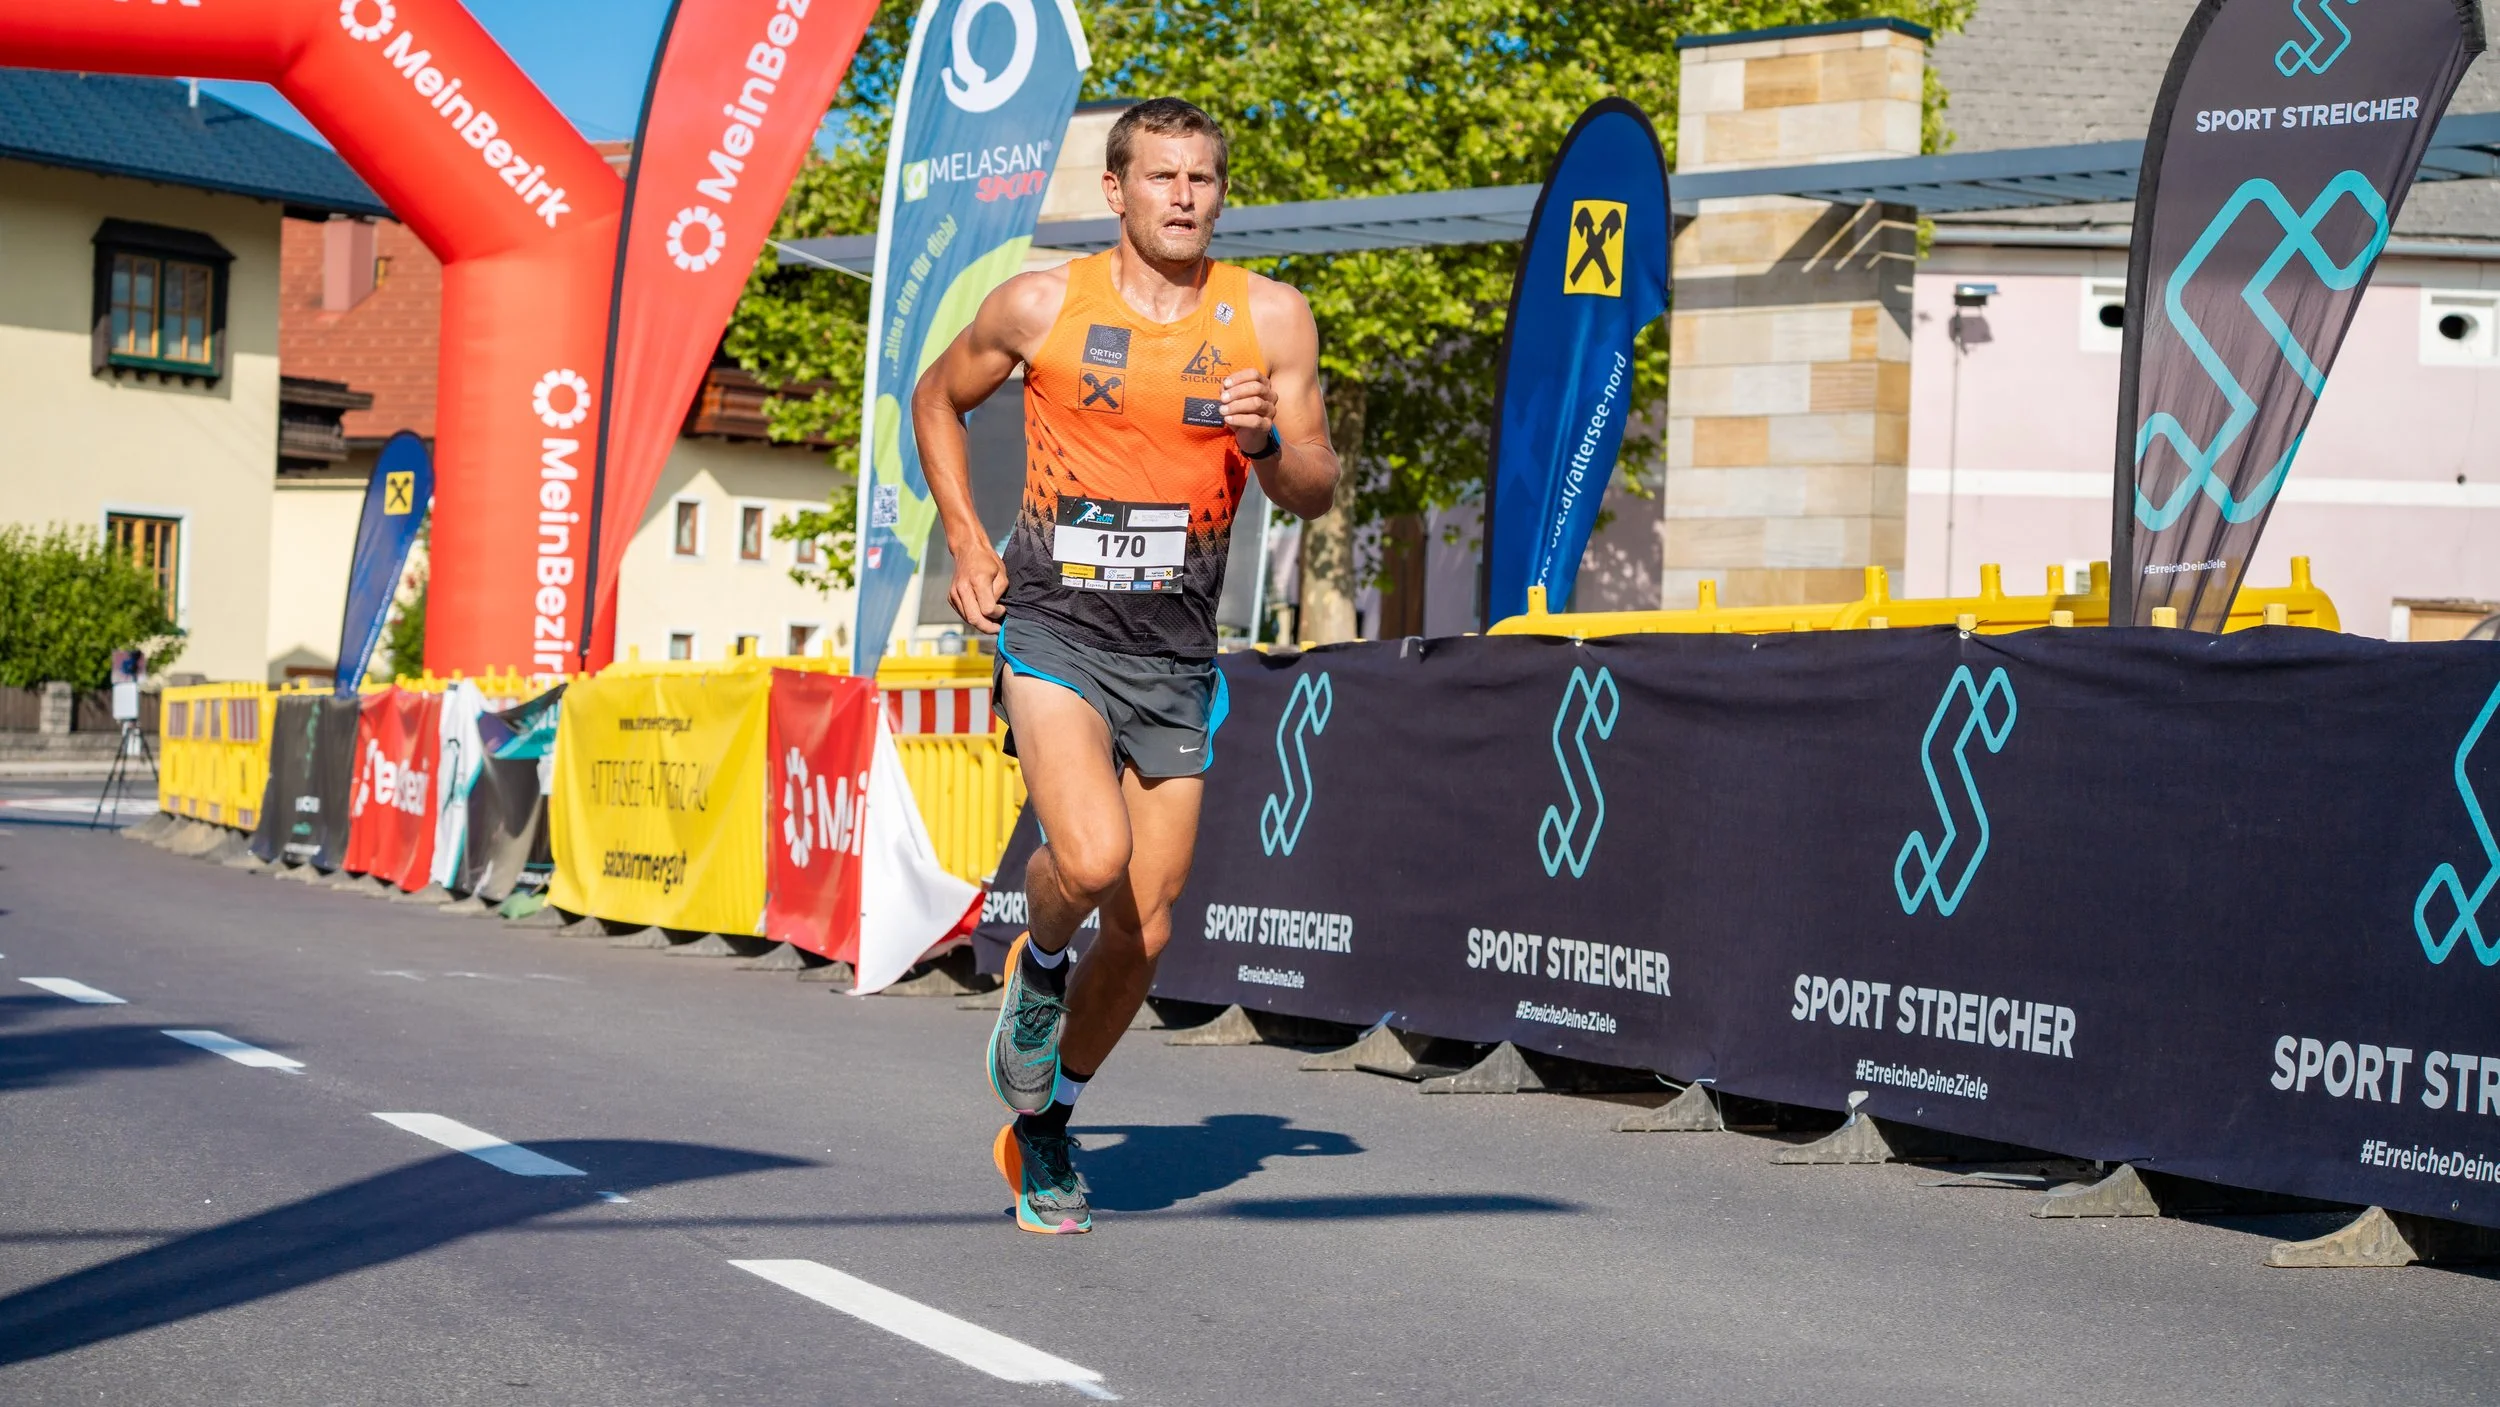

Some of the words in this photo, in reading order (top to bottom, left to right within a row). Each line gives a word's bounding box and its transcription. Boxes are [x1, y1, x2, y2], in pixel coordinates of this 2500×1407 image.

[383, 31, 571, 228] MeinBezirk
[2196, 108, 2276, 133] SPORT
[2281, 96, 2419, 129] STREICHER
[1090, 347, 1122, 360] ORTHO
[1097, 533, 1146, 558] 170
[1204, 903, 1259, 944] SPORT
[1257, 907, 1354, 954] STREICHER
[1238, 964, 1306, 990] #ErreicheDeineZiele
[1467, 927, 1542, 976] SPORT
[1546, 936, 1672, 997] STREICHER
[1515, 1000, 1617, 1035] #ErreicheDeineZiele
[1791, 974, 1892, 1030] SPORT
[1896, 985, 2077, 1059] STREICHER
[1855, 1059, 1989, 1101] #ErreicheDeineZiele
[2270, 1035, 2413, 1104] SPORT
